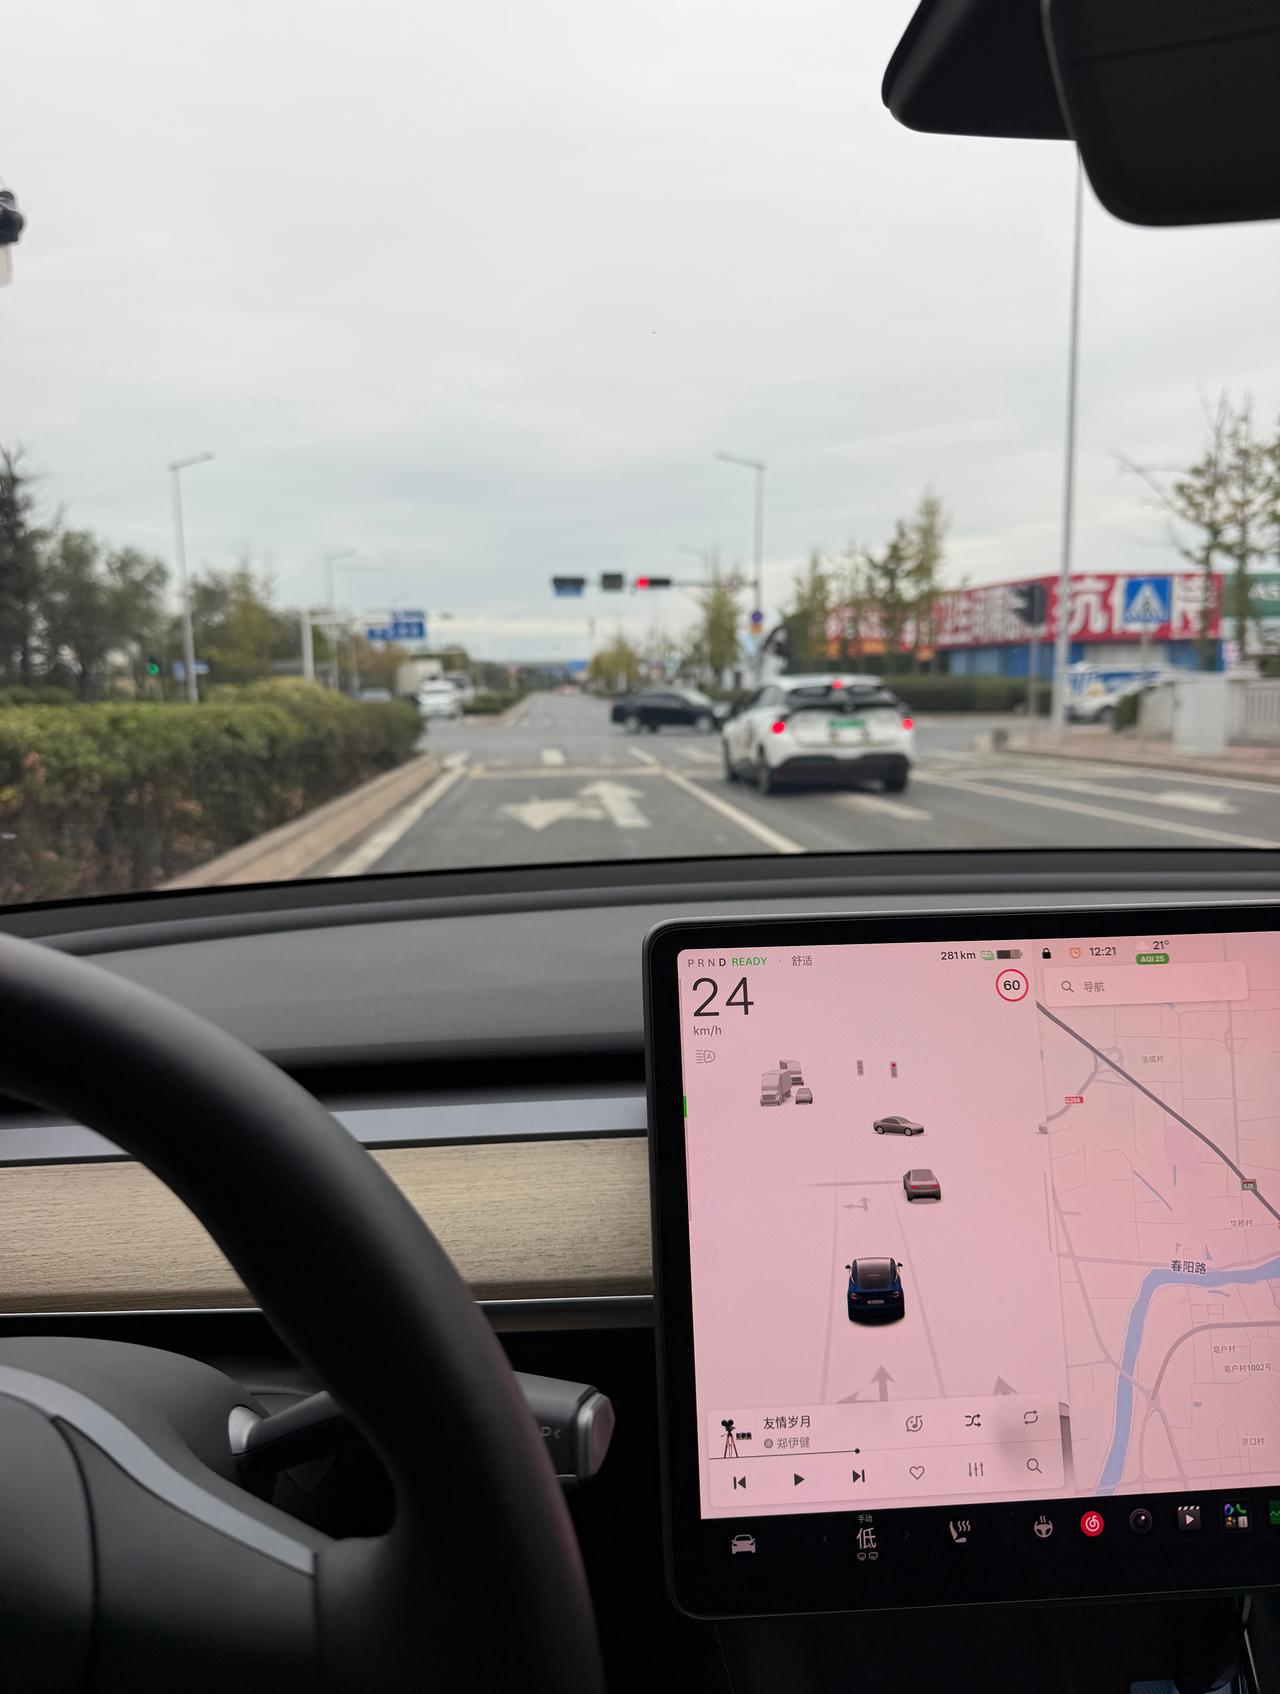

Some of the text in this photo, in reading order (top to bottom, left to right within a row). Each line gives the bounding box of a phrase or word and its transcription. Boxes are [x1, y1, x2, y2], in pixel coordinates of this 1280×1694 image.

[1089, 946, 1117, 957] 12:21
[1152, 940, 1170, 951] 21°
[732, 957, 767, 966] READY
[791, 955, 813, 967] 舒适
[1003, 980, 1021, 991] 60
[1083, 981, 1105, 993] 导航
[692, 977, 754, 1017] 24
[693, 1026, 722, 1037] km/h
[1171, 1259, 1206, 1275] 春阳路
[763, 1415, 811, 1429] 友情岁月
[777, 1436, 810, 1449] 郑伊健
[856, 1527, 876, 1550] 低
